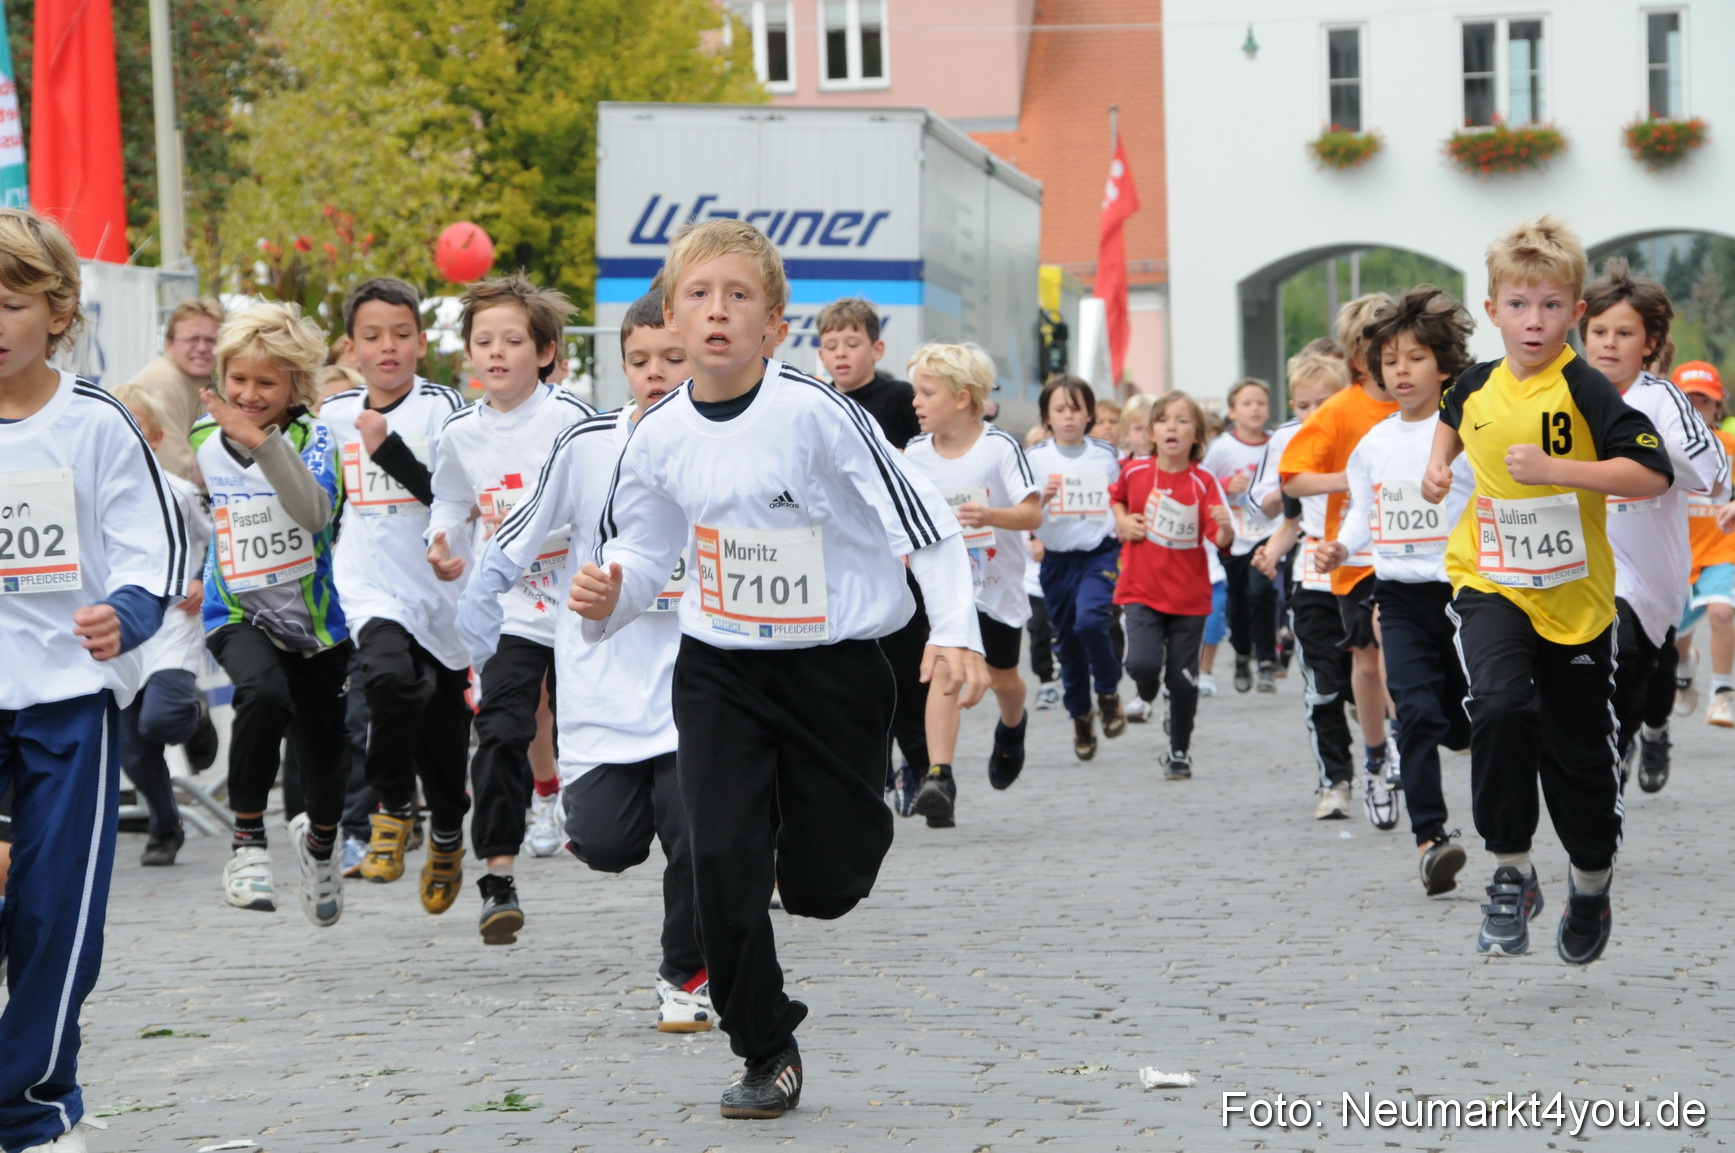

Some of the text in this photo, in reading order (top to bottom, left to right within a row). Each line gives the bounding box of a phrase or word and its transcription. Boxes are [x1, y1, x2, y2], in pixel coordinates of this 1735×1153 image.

[1542, 411, 1572, 456] 13
[1065, 477, 1082, 487] Nick
[1066, 491, 1104, 507] 7117
[1382, 487, 1404, 502] Paul
[769, 501, 800, 509] adidas
[232, 506, 273, 528] Pascal
[1157, 515, 1196, 536] 7135
[1385, 508, 1439, 531] 7020
[1499, 508, 1538, 526] Julian
[236, 526, 303, 563] 7055
[1483, 530, 1497, 544] B4
[1505, 529, 1574, 561] 7146
[723, 538, 778, 563] Moritz
[20, 572, 79, 586] PFLEIDERER
[1543, 565, 1586, 583] PFLEIDERER
[727, 572, 809, 606] 7101
[773, 623, 826, 635] PFLEIDERER
